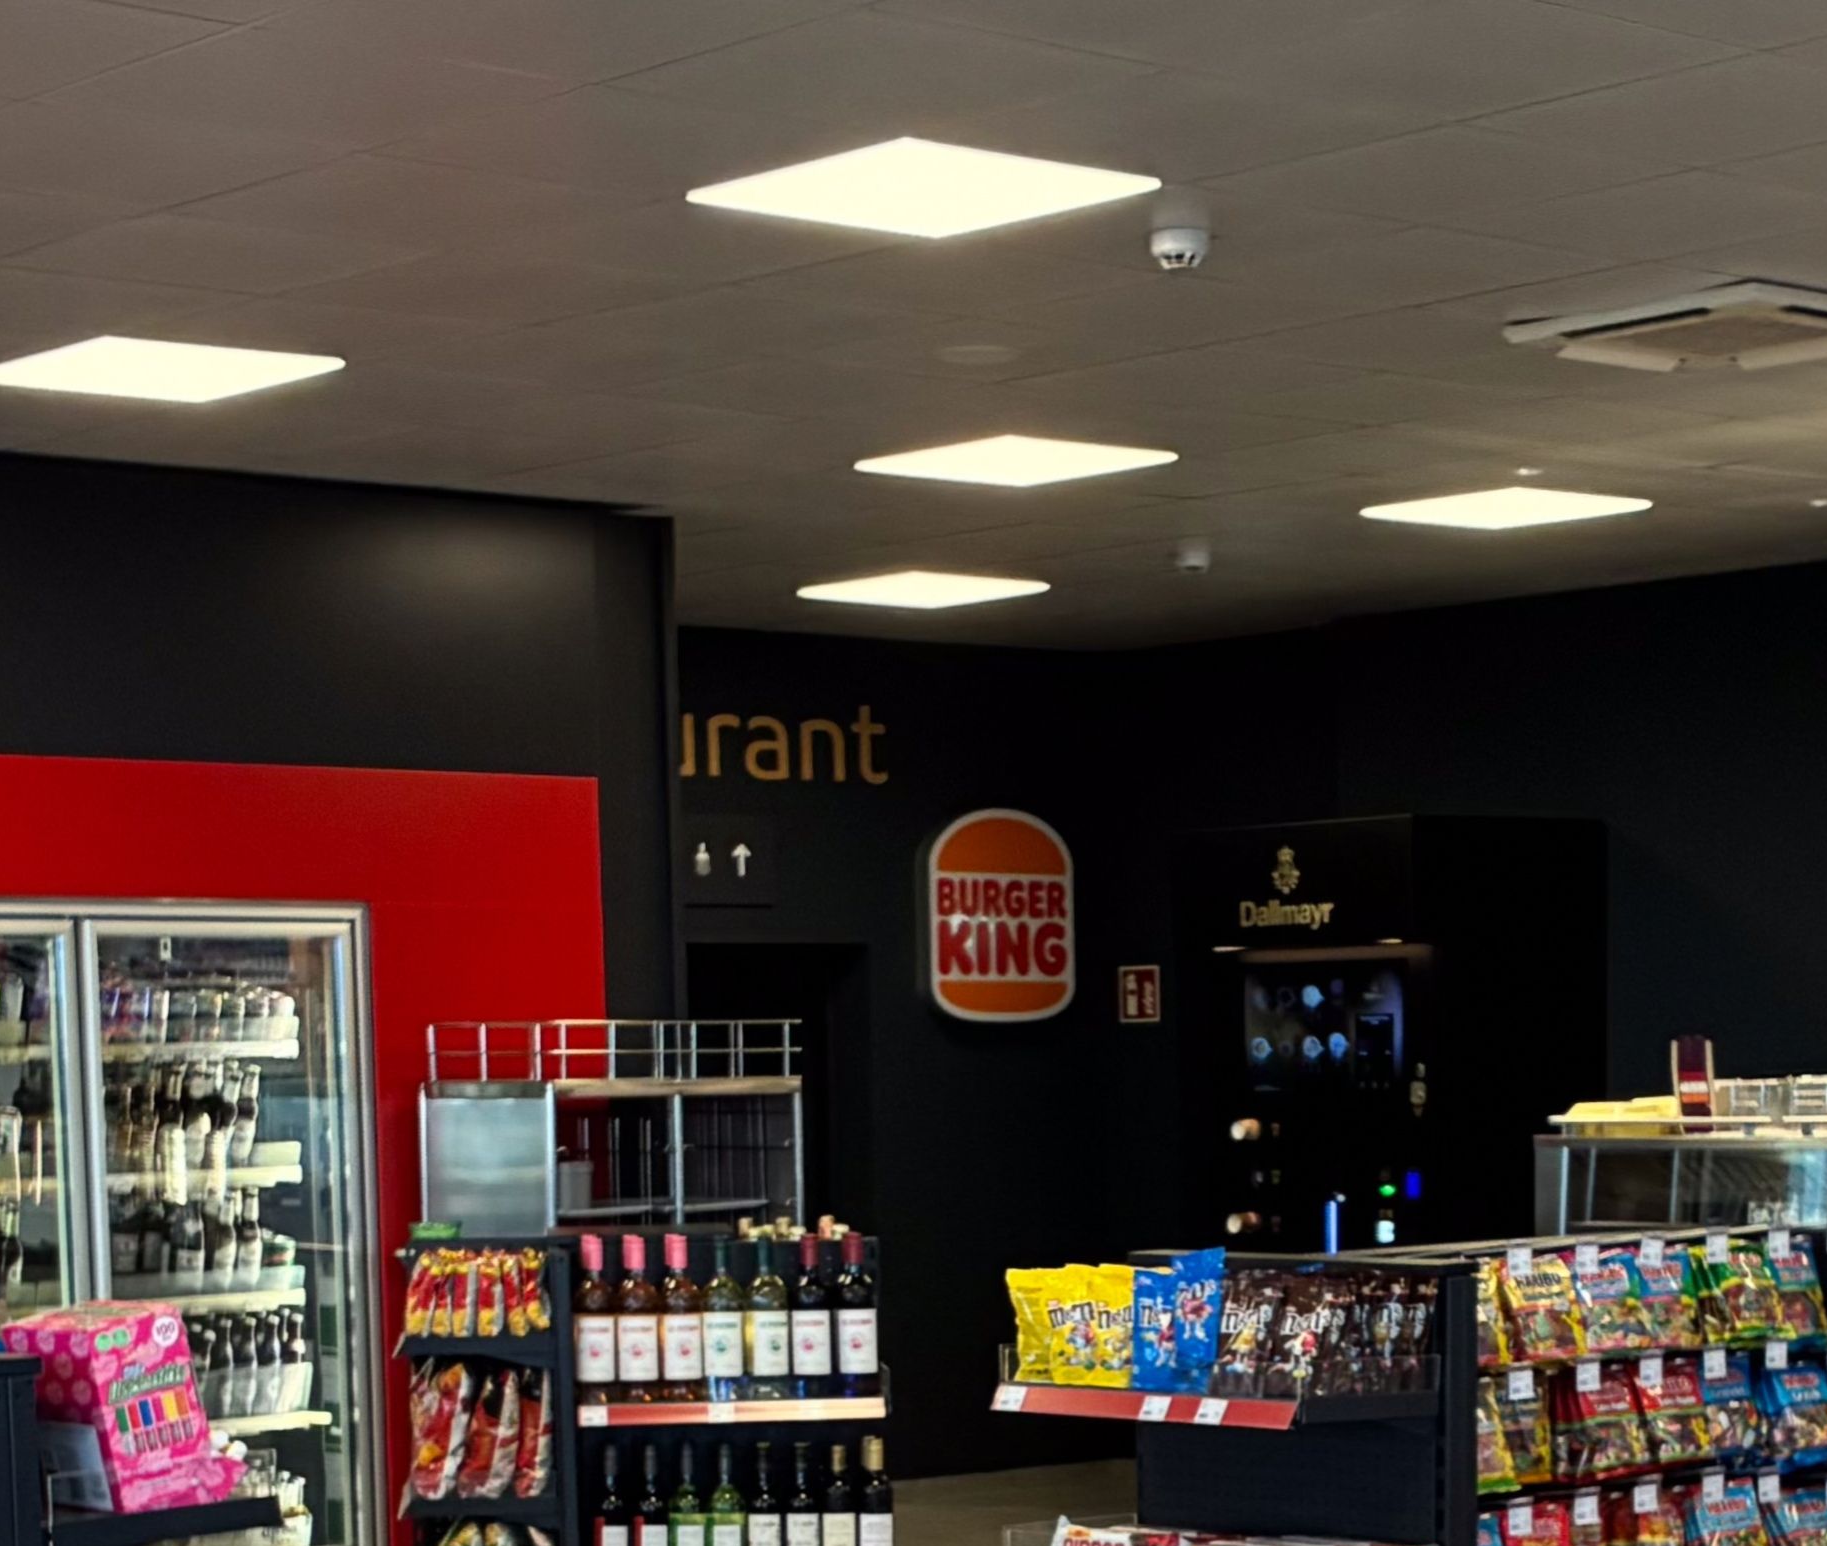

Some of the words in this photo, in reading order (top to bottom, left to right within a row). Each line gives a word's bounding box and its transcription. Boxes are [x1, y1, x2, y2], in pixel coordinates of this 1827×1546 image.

[936, 877, 1067, 920] BURGER
[1239, 900, 1334, 930] Dallmayr
[937, 920, 1068, 978] KING
